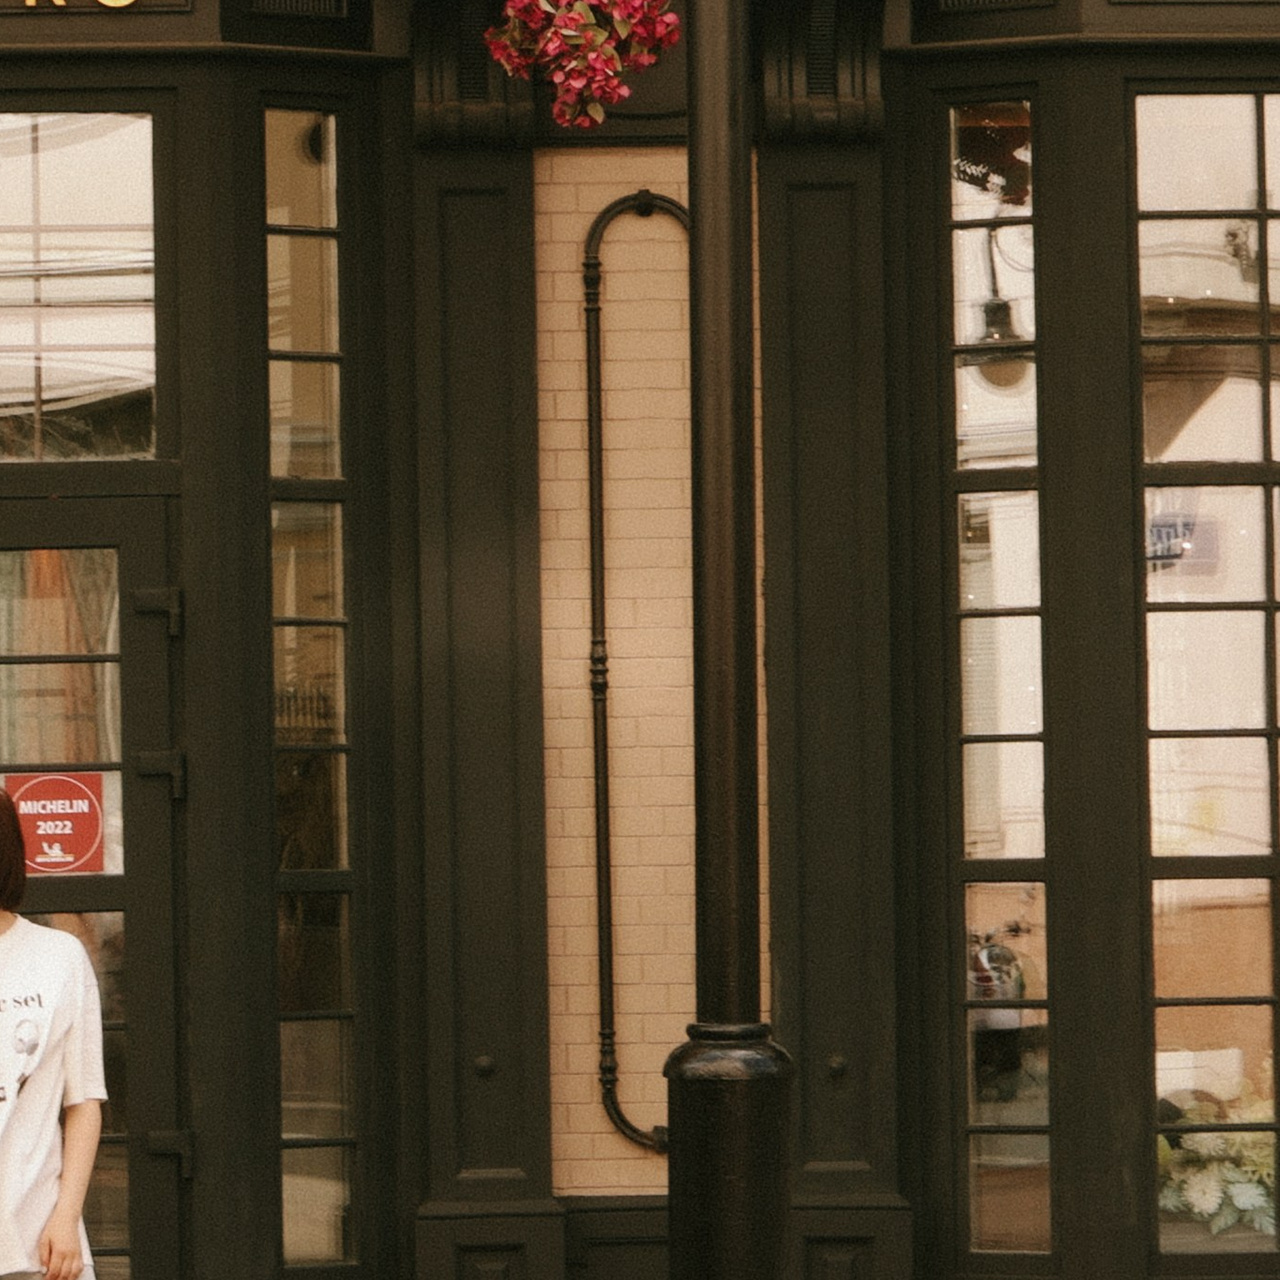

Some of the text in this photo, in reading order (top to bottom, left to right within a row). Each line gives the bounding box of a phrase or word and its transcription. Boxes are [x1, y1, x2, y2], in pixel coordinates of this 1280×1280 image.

[19, 800, 90, 814] MICHELIN
[36, 820, 73, 835] 2022
[13, 993, 44, 1009] set
